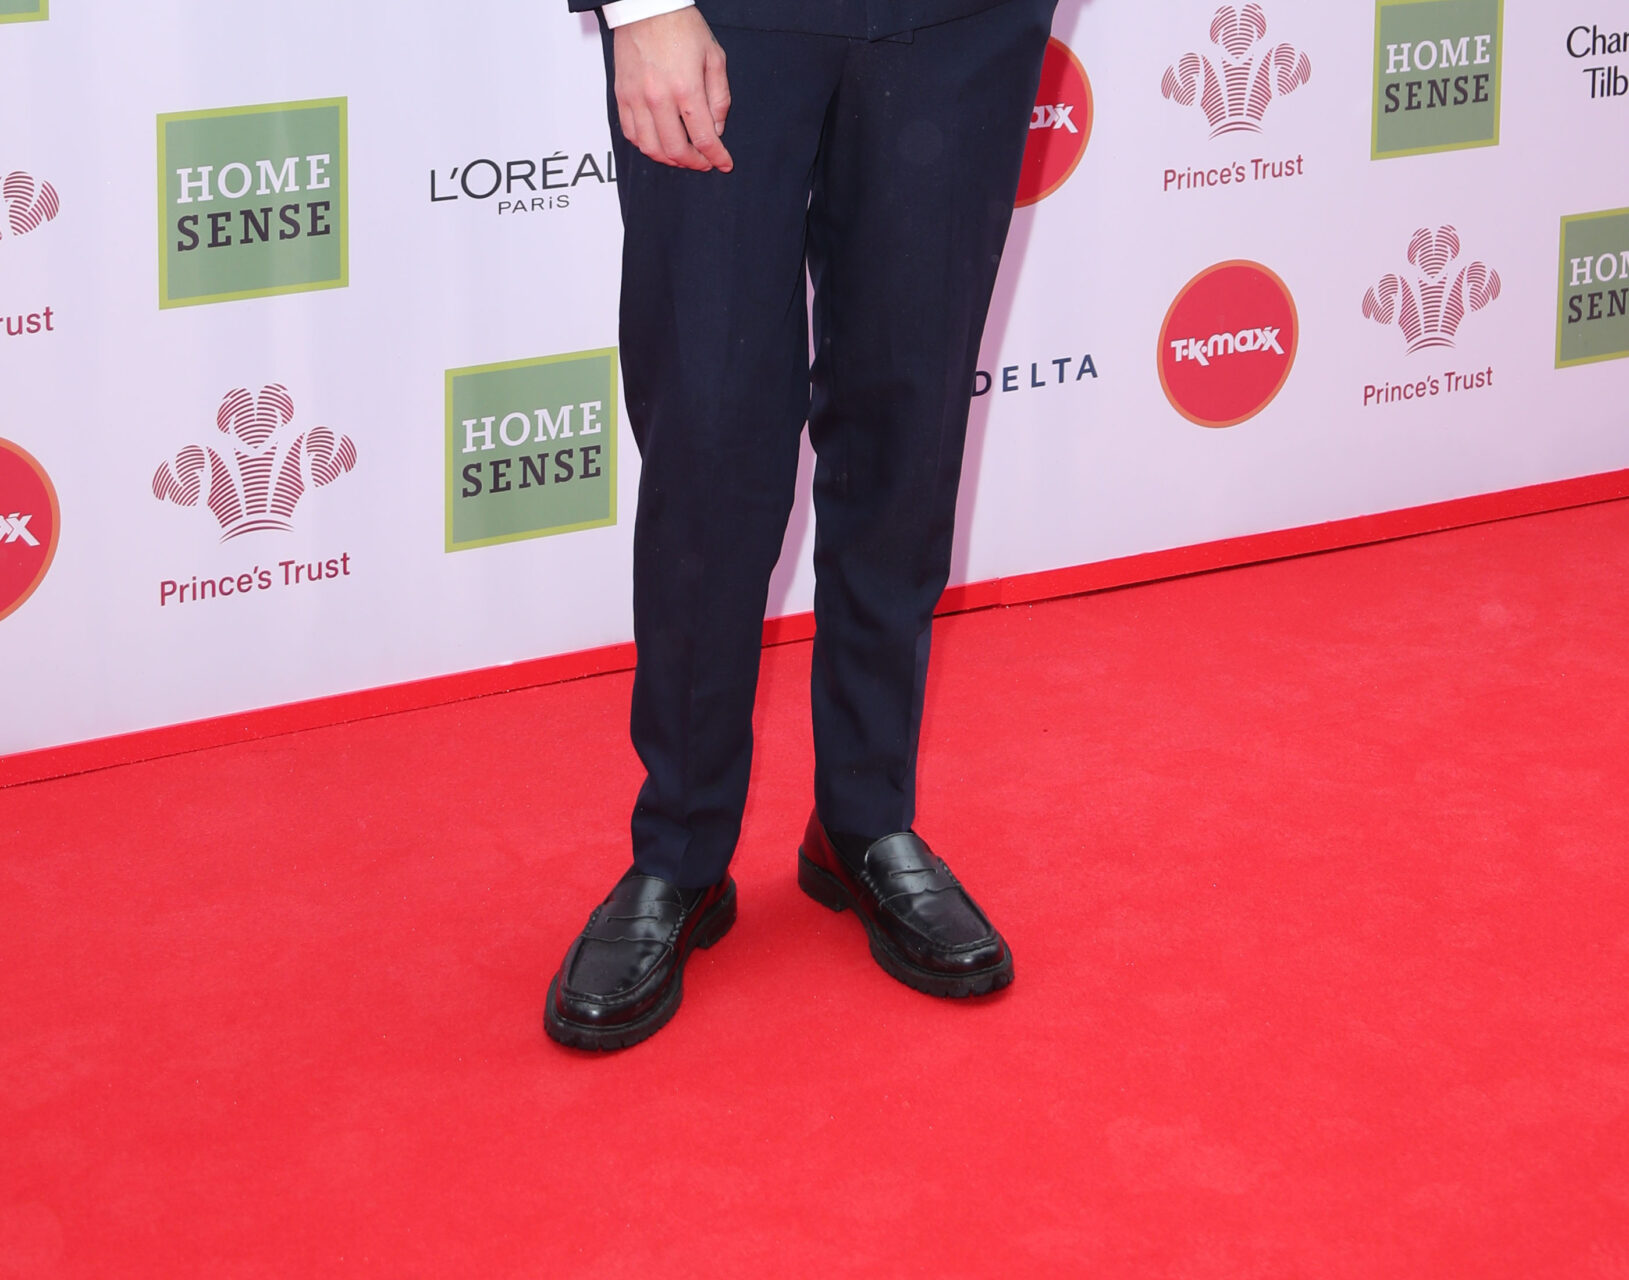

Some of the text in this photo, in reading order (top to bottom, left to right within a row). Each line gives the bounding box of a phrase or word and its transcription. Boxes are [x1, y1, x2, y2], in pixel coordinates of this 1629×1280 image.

[1386, 35, 1490, 73] HOME
[1385, 74, 1489, 113] SENSE
[177, 154, 330, 203] HOME
[1164, 155, 1303, 191] Prince's Trust
[178, 201, 330, 251] SENSE
[971, 354, 1098, 397] DELTA
[1364, 367, 1493, 406] Prince's Trust
[462, 401, 601, 452] HOME
[462, 446, 601, 498] SENSE
[161, 552, 350, 606] Prince's Trust
